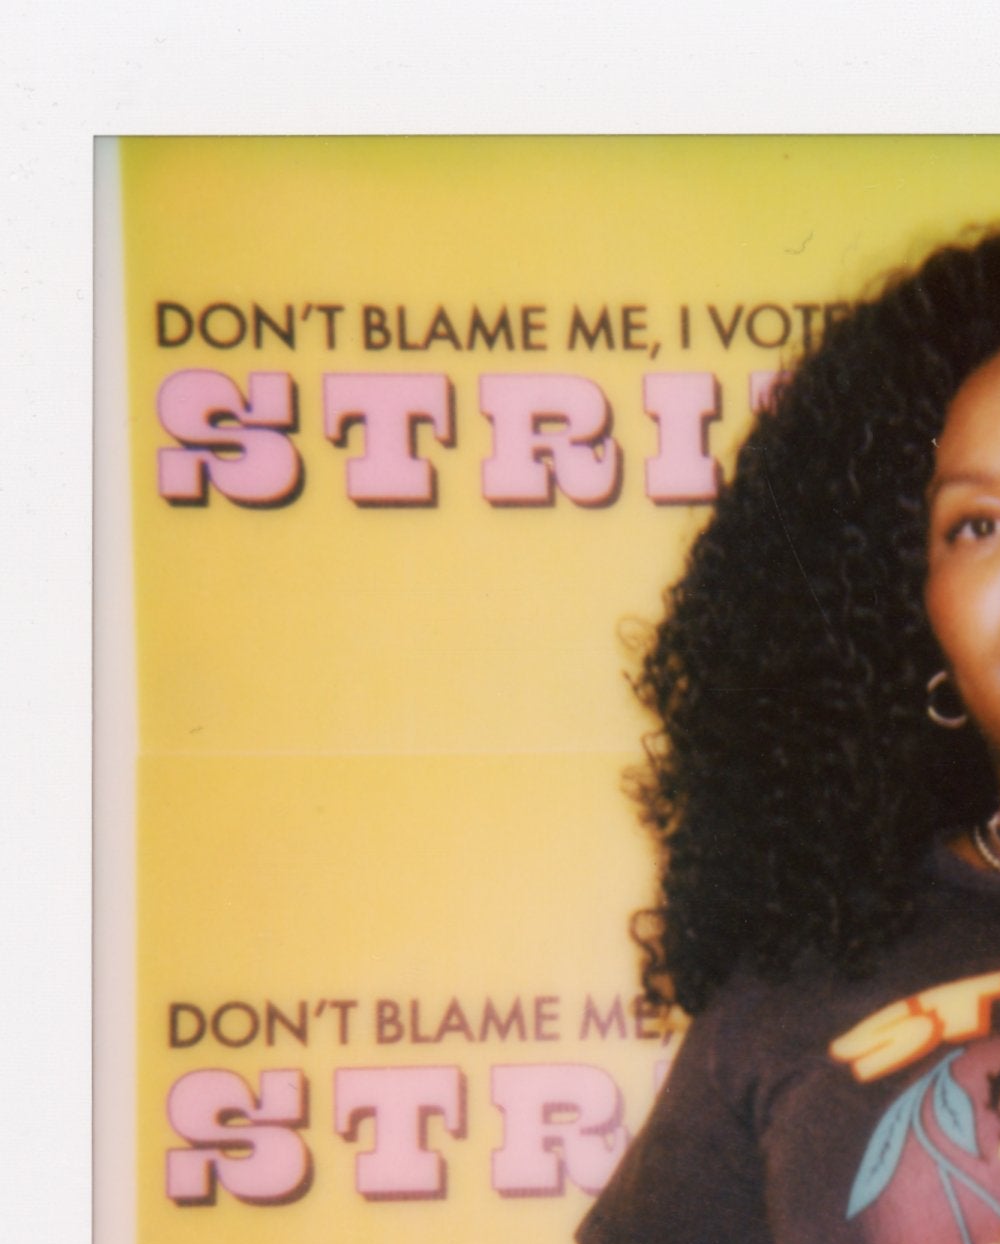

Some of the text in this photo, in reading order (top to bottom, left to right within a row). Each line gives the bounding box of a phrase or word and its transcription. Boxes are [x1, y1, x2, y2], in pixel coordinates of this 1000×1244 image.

[156, 301, 344, 351] DON'T
[362, 304, 547, 352] BLAME
[568, 304, 661, 359] ME,
[681, 306, 690, 350] I
[157, 368, 790, 509] STRI
[168, 993, 672, 1049] DON'T BLAME ME,
[165, 1061, 671, 1208] STR
